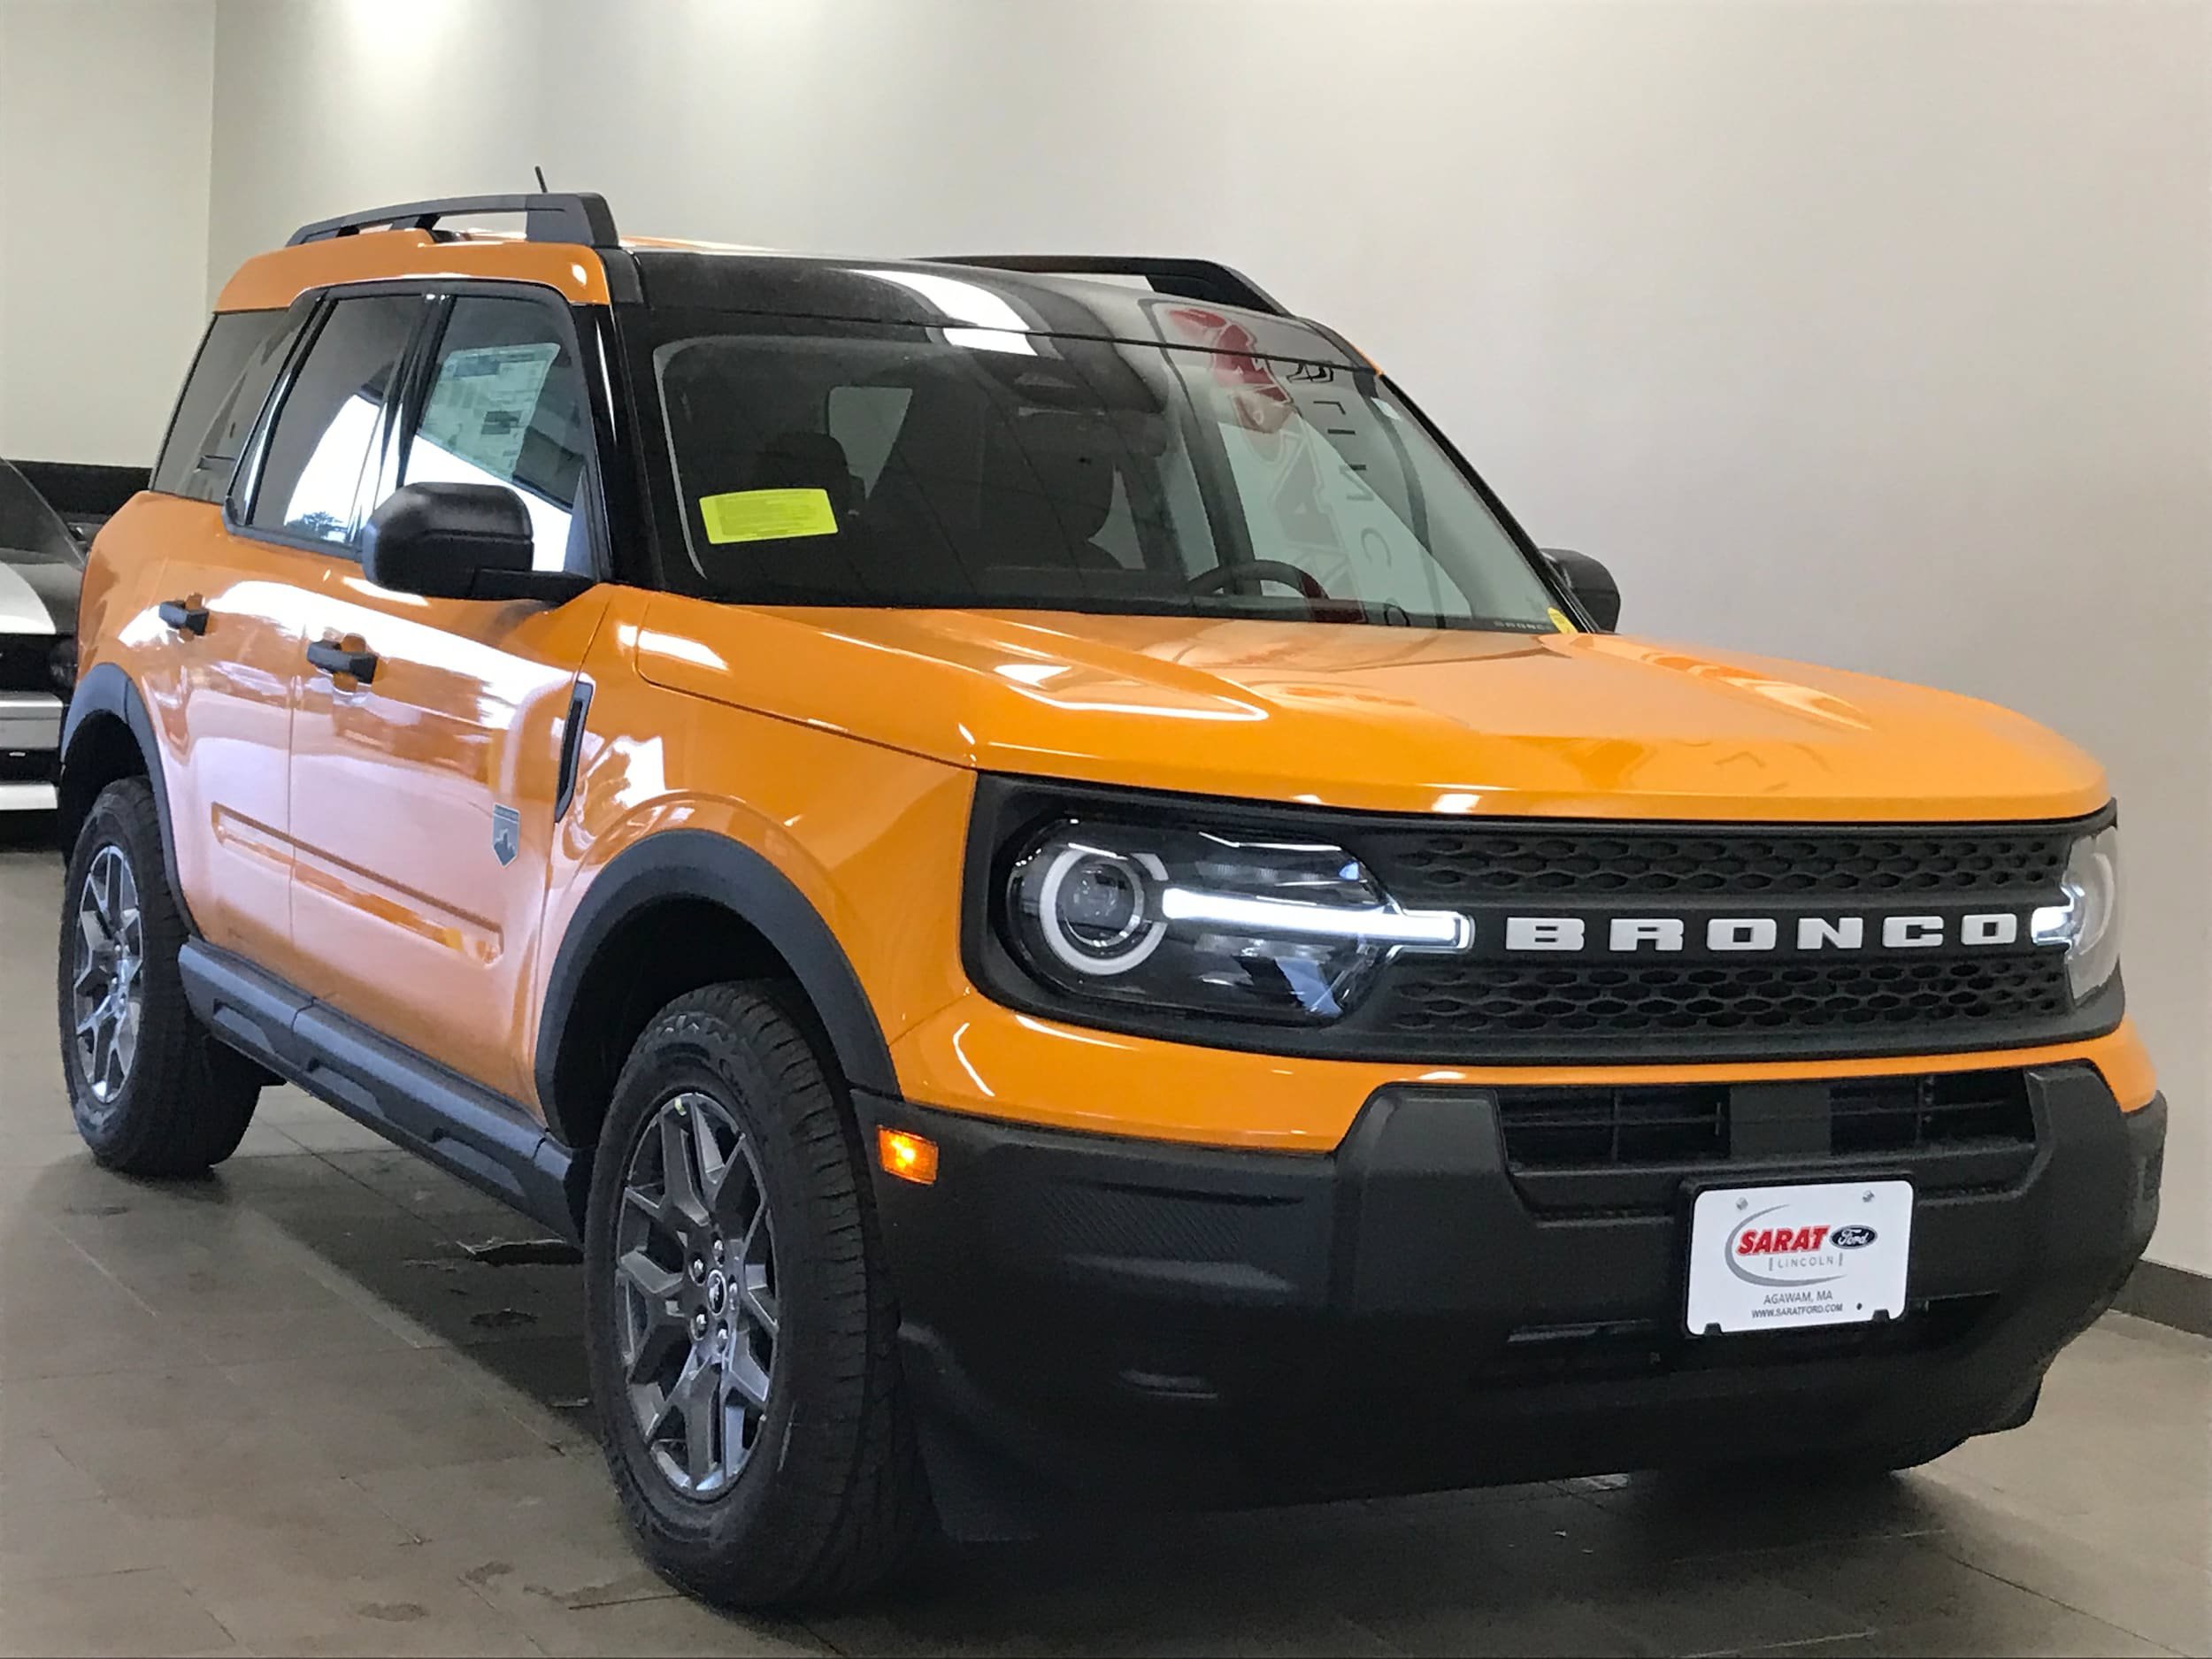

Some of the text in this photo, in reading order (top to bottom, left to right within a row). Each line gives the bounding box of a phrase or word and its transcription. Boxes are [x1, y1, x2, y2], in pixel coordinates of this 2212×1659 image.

[1505, 912, 2018, 952] BRONCO
[1737, 1225, 1869, 1255] SARAT Ford
[1778, 1256, 1834, 1269] LINCOLN
[1763, 1290, 1833, 1304] AGAWAM, MA
[1752, 1304, 1843, 1318] WWW.SARATFORD.COM
